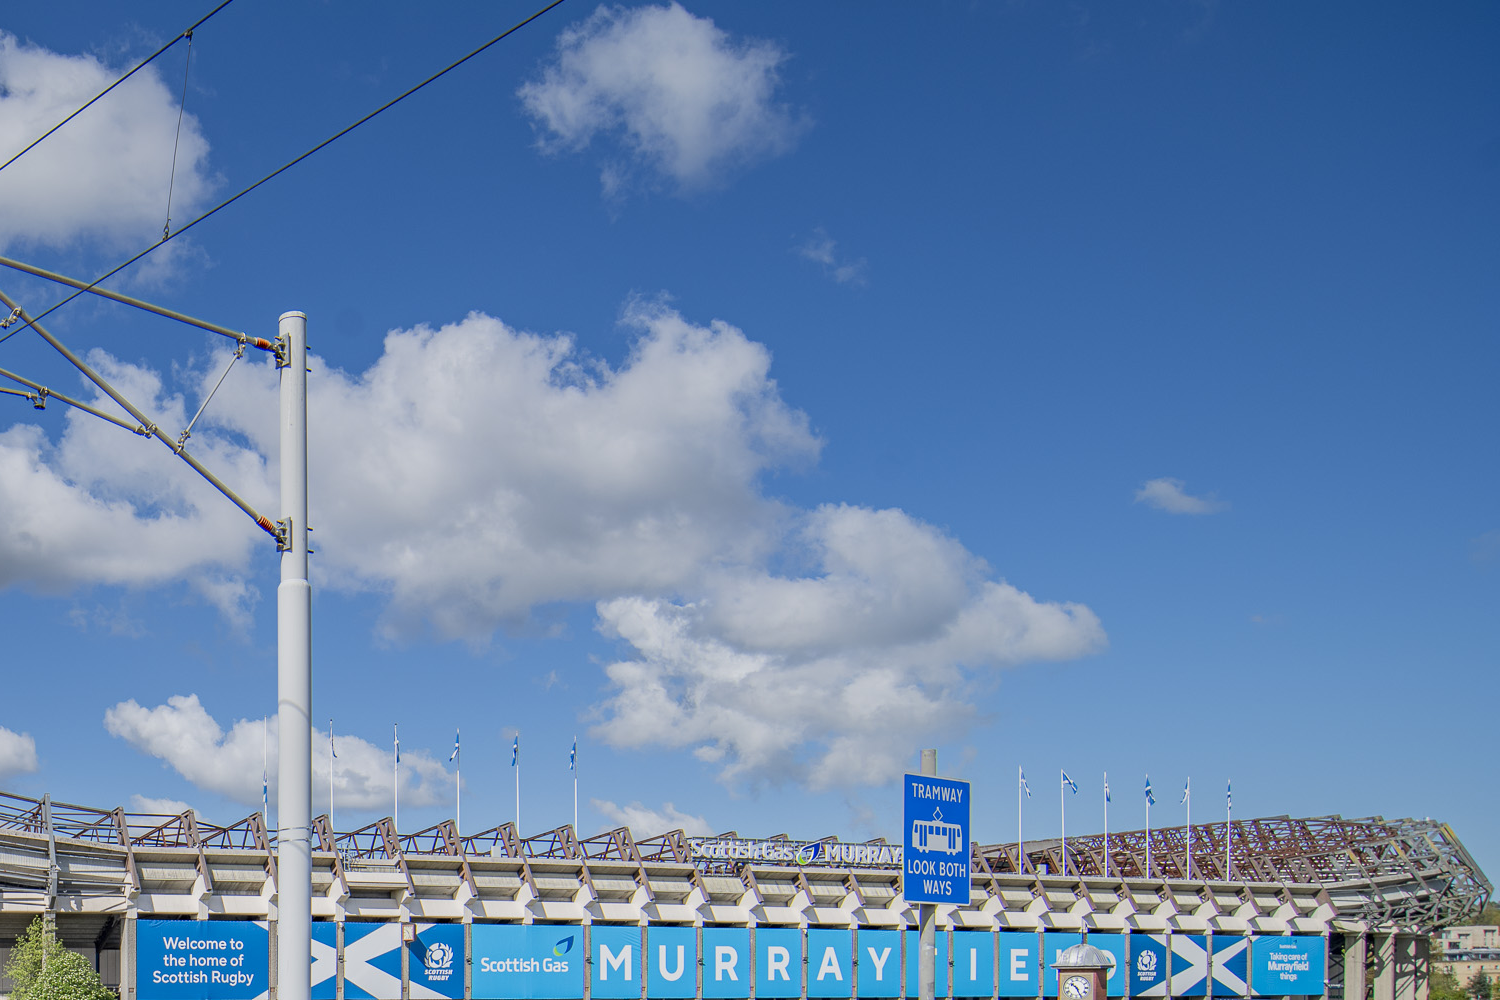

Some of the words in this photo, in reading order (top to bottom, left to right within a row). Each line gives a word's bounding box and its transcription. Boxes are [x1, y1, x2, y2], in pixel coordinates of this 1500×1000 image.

[912, 783, 963, 803] TRAMWAY
[691, 839, 761, 860] Scottish
[762, 842, 794, 861] Gas
[908, 859, 936, 876] LOOK
[939, 861, 966, 878] BOTH
[923, 879, 952, 896] WAYS
[163, 936, 227, 950] Welcome
[229, 938, 244, 950] to
[163, 954, 186, 967] the
[189, 954, 227, 967] home
[230, 954, 244, 967] of
[481, 957, 540, 973] Scottish
[542, 957, 569, 973] Gas
[1269, 953, 1287, 962] Taking
[1299, 953, 1308, 961] of
[1268, 961, 1309, 973] Murrayfield
[152, 970, 208, 984] Scottish
[211, 970, 254, 986] Rugby
[1279, 972, 1297, 981] things
